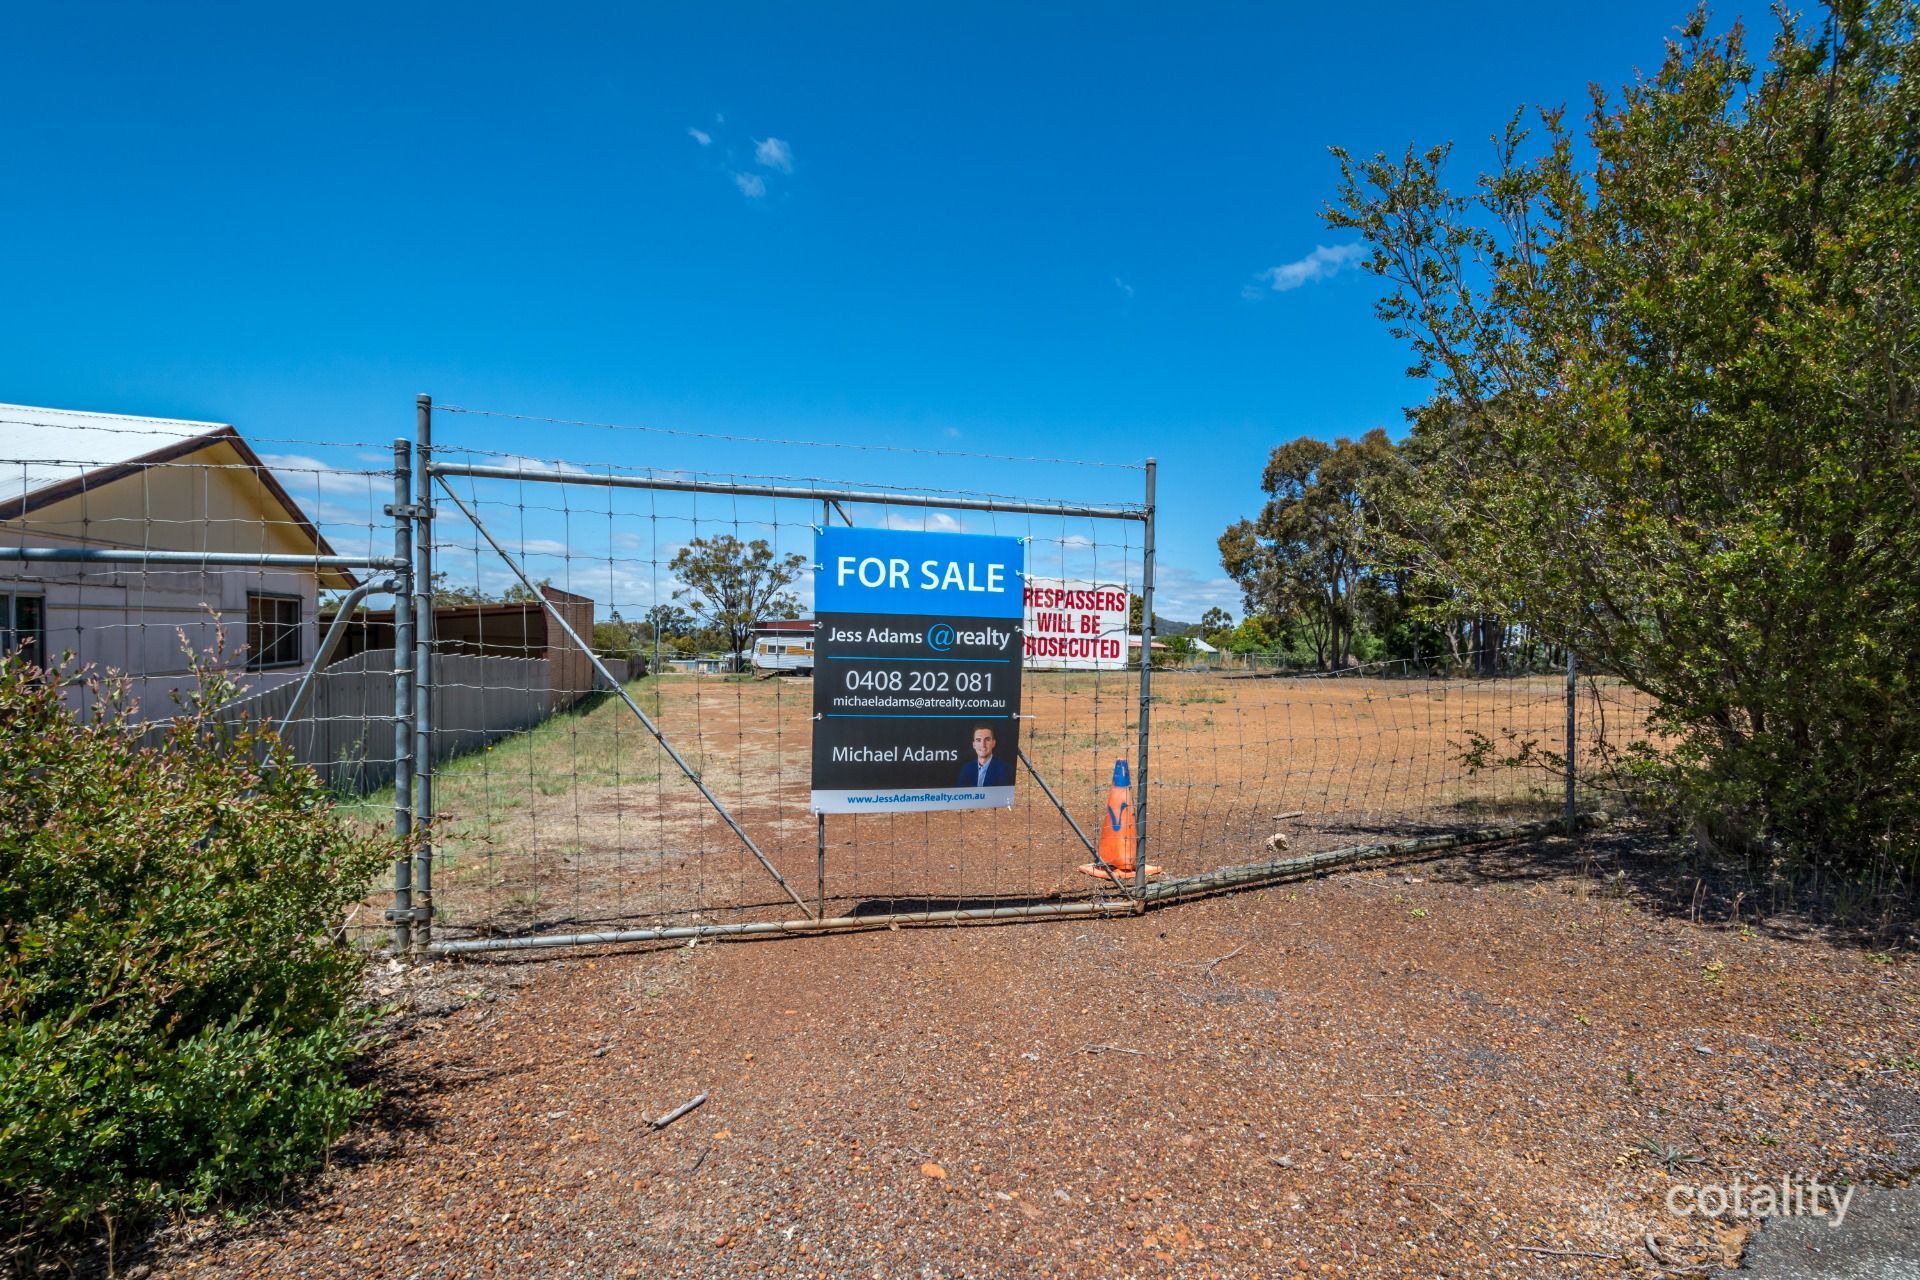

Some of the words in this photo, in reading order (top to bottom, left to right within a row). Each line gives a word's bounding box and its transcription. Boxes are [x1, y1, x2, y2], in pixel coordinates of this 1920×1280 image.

[838, 556, 910, 589] FOR
[920, 560, 1005, 593] SALE
[1023, 587, 1126, 612] RESPASSERS
[1037, 612, 1075, 633] WILL
[1080, 614, 1101, 634] BE
[828, 627, 863, 643] Jess
[866, 627, 923, 644] Adams
[1021, 634, 1120, 659] ROSECUTED
[845, 670, 903, 691] 0408
[909, 671, 950, 692] 202
[955, 672, 993, 692] 081
[833, 695, 1006, 710] michaeladams@atrealty.com.au
[832, 746, 898, 762] Michael
[902, 746, 958, 762] Adams
[847, 791, 986, 804] www.JessAdamsRealty.com.au
